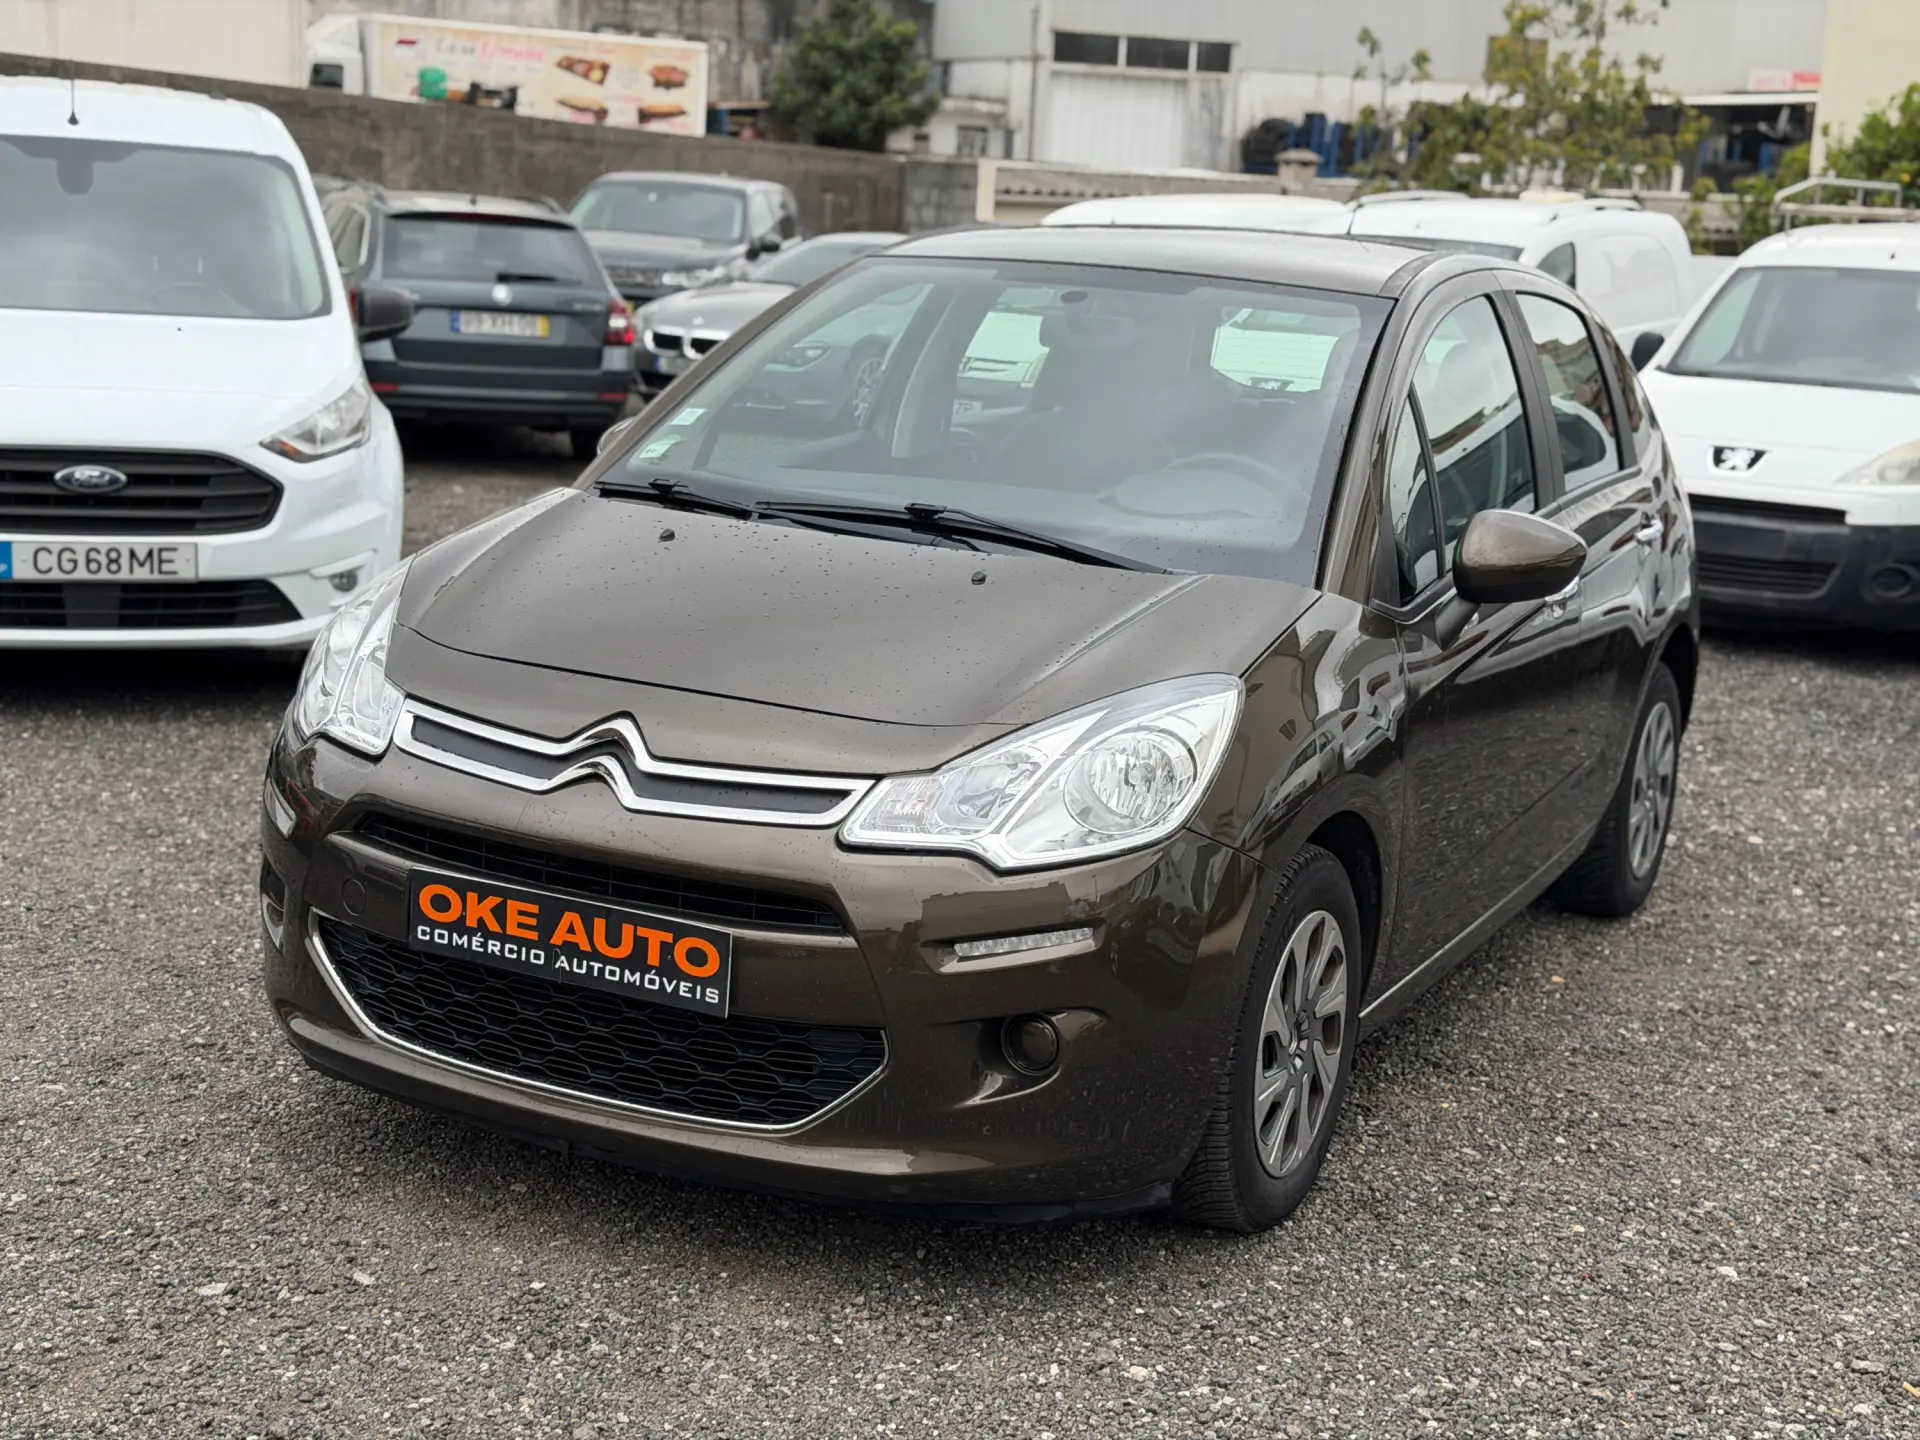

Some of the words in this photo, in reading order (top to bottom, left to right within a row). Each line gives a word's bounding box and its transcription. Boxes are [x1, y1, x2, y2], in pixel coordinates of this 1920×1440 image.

[32, 546, 179, 576] CG68ME
[417, 925, 545, 965] COMÉRCIO
[554, 954, 719, 1004] AUTOMÓVEIS
[418, 884, 540, 941] OKE
[549, 911, 721, 978] AUTO
